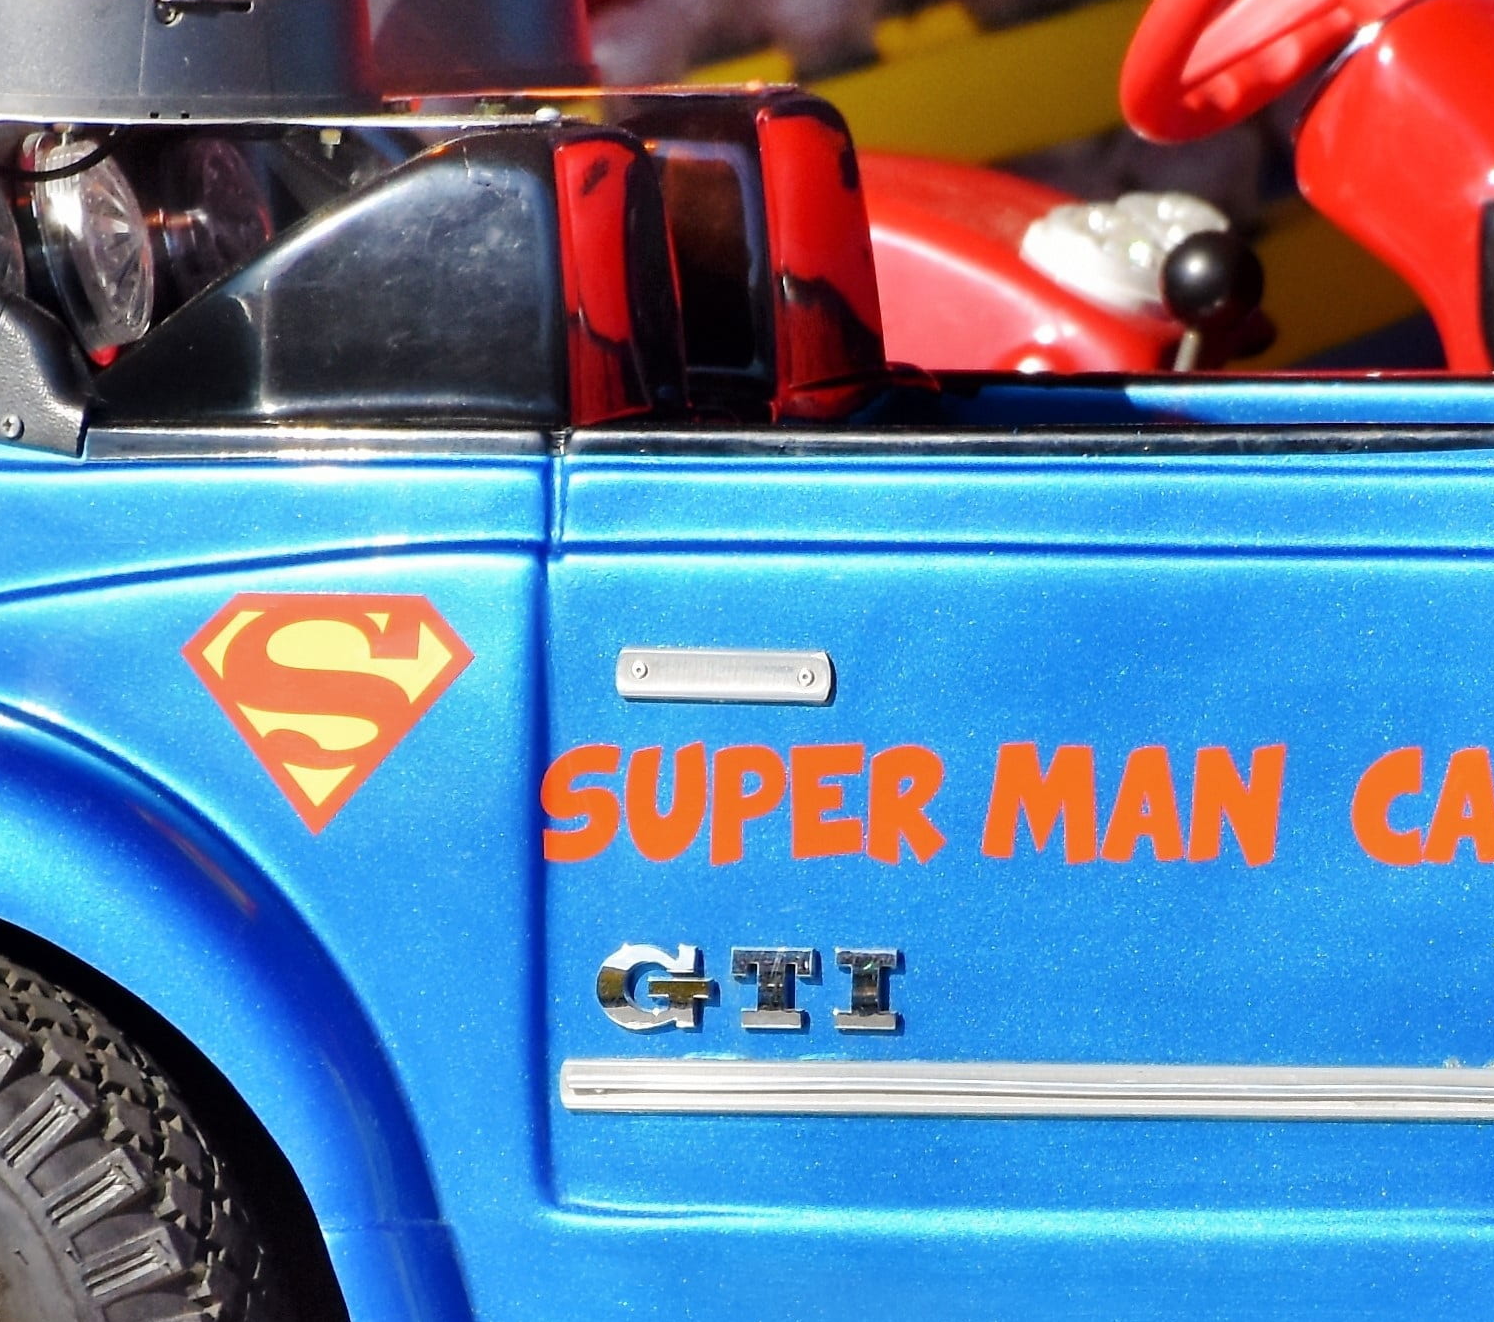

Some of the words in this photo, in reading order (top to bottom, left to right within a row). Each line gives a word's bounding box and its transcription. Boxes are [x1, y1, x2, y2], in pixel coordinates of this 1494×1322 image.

[196, 596, 456, 810] S
[540, 742, 946, 865] SUPER
[981, 743, 1287, 866] MAN
[596, 943, 900, 1032] GTI
